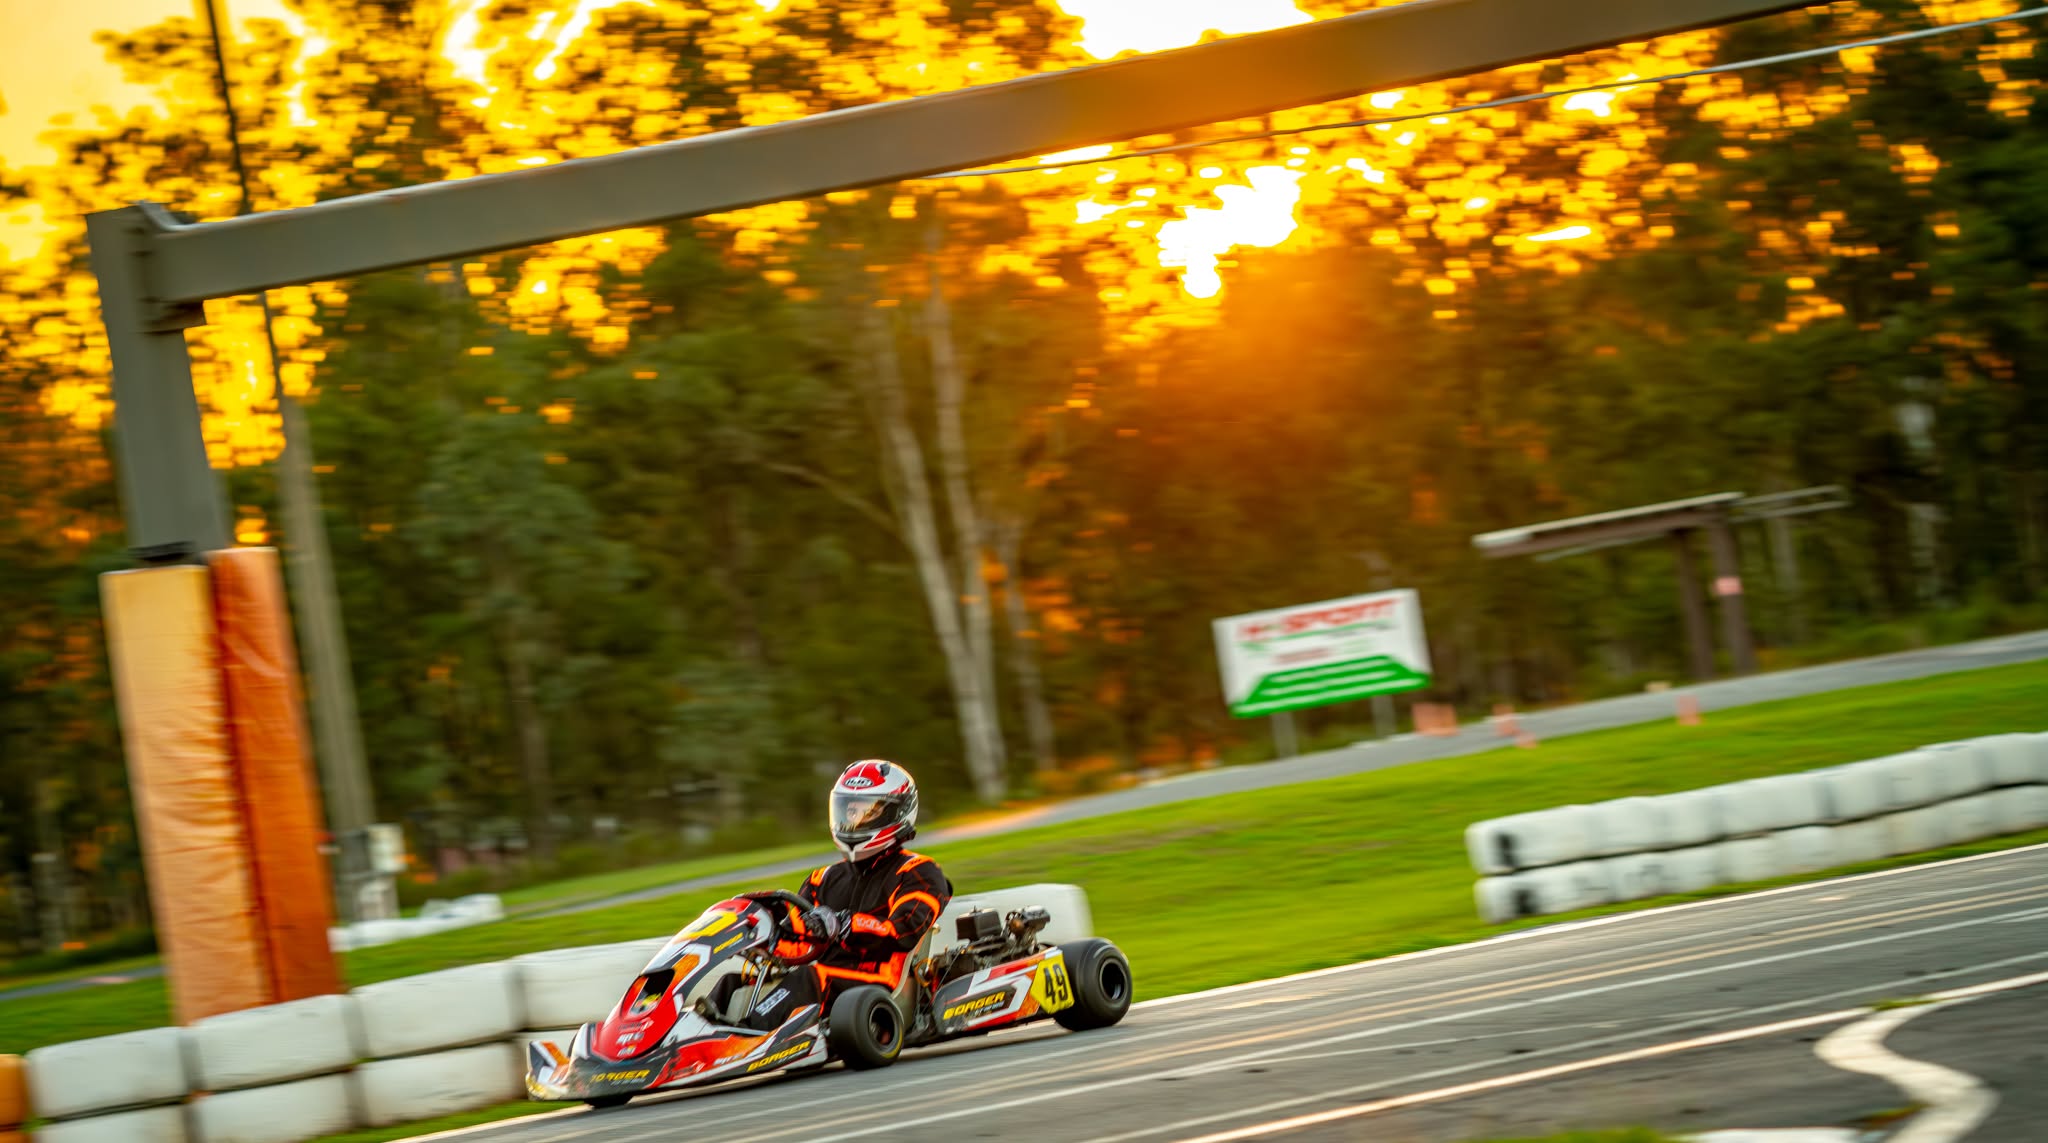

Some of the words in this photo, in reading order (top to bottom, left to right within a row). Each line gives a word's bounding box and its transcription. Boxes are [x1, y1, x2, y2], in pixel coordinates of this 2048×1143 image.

[1043, 963, 1069, 1005] 49
[943, 991, 1006, 1020] BORGER
[745, 1040, 812, 1072] BORGER
